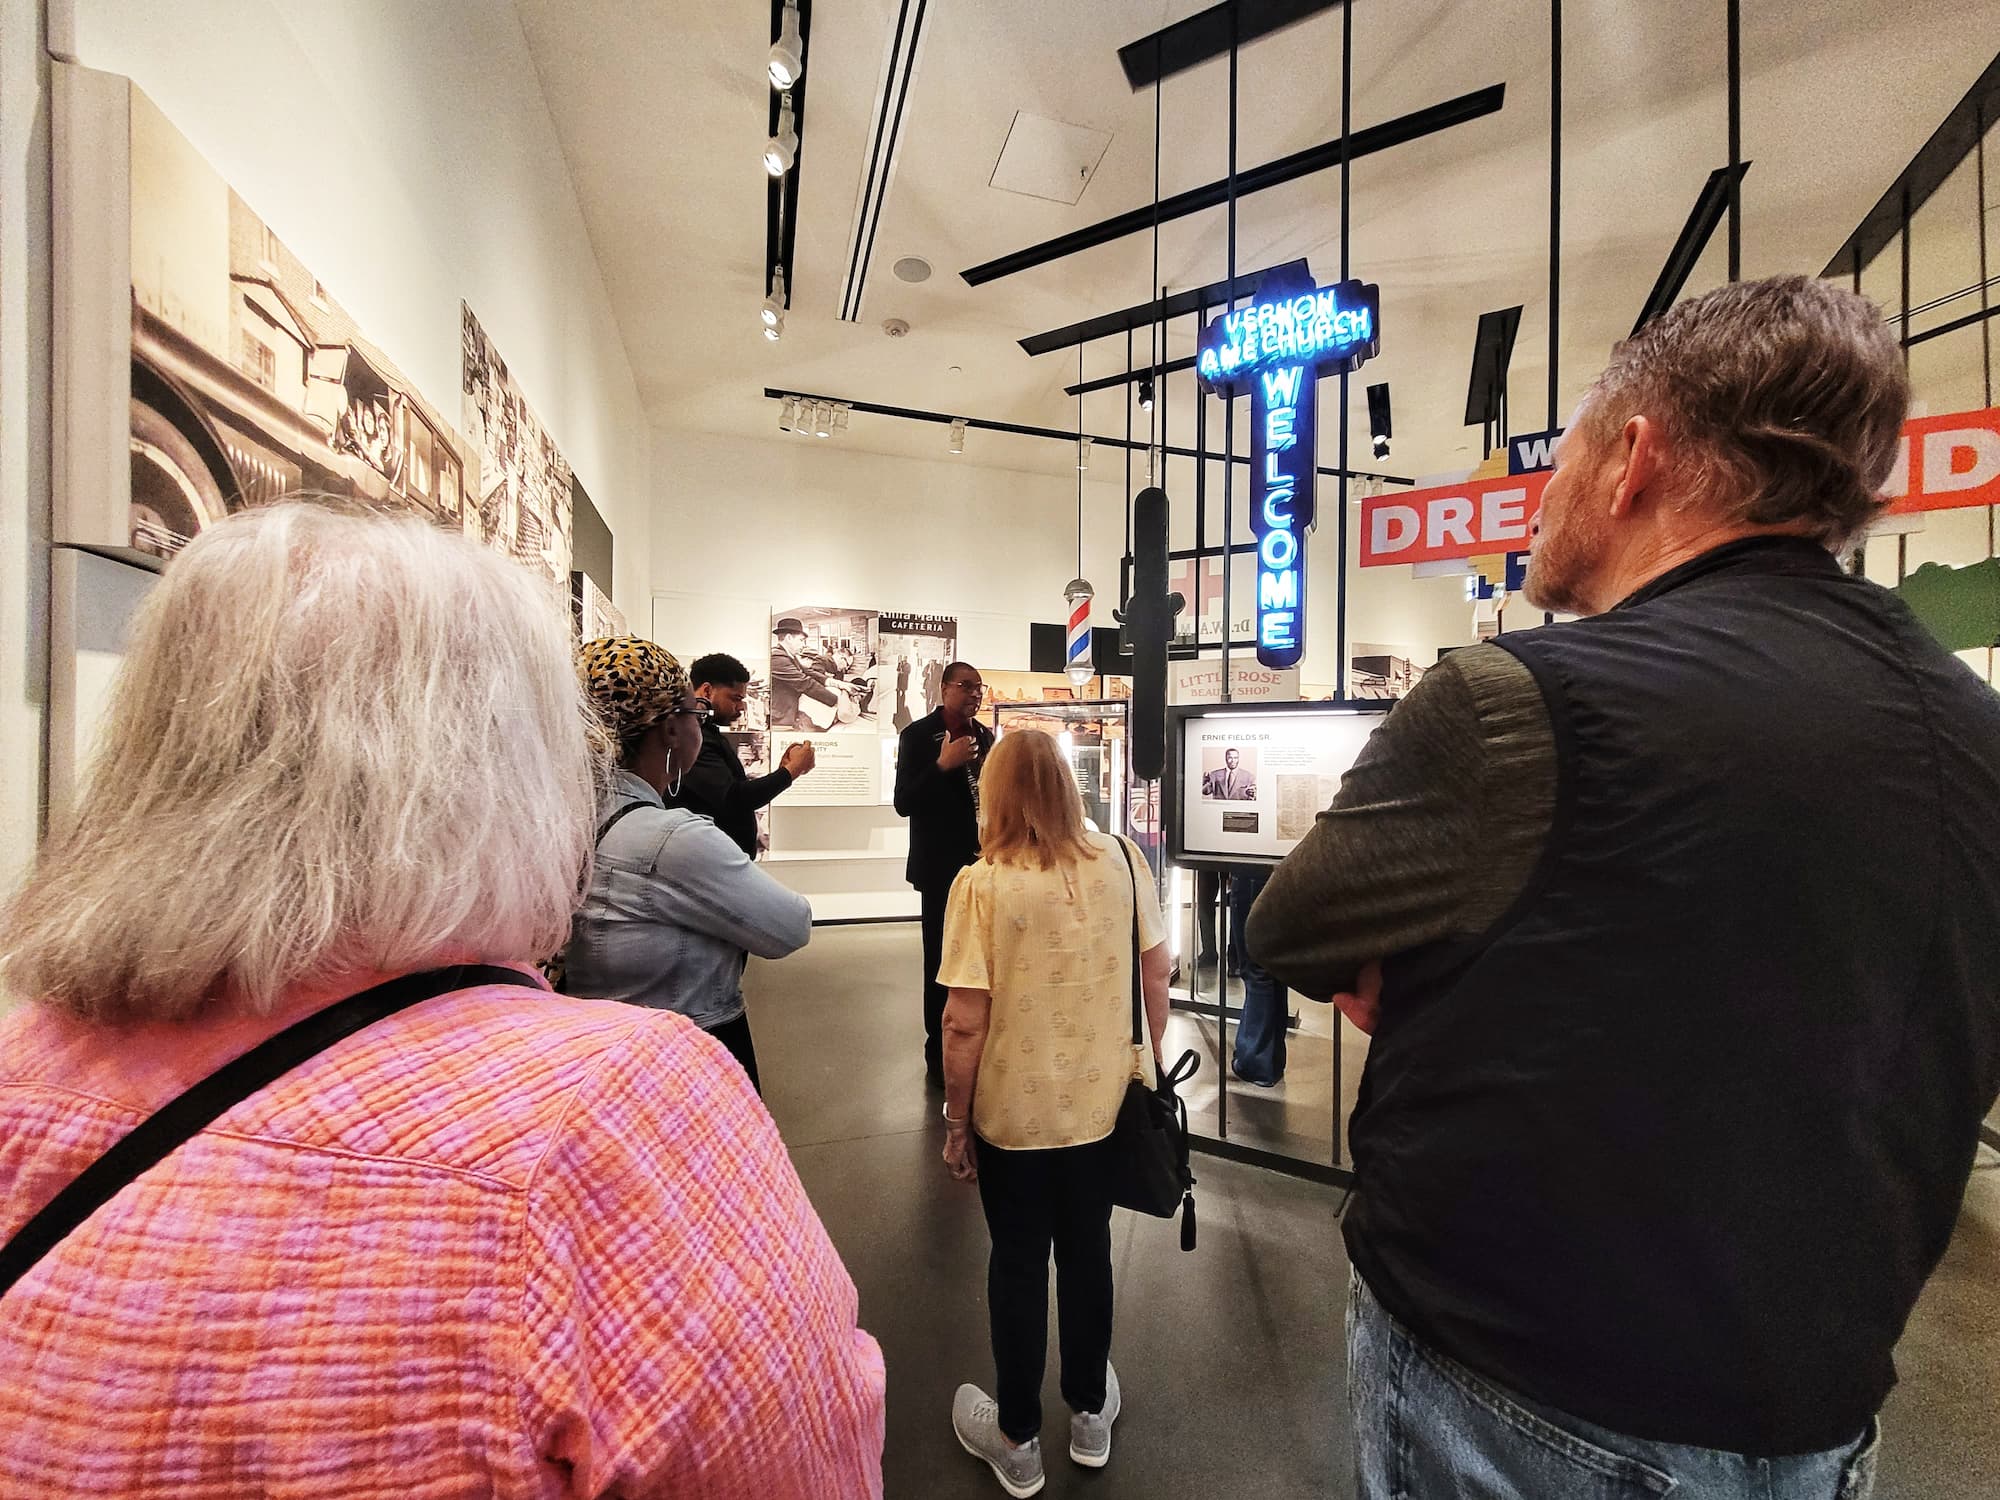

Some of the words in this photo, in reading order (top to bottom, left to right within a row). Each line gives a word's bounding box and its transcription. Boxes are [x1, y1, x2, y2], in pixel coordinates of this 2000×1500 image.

[1225, 290, 1335, 334] VERNON
[1262, 308, 1369, 355] CHURCH
[1261, 366, 1299, 649] WELCOME
[1371, 488, 1527, 554] DRE
[891, 621, 943, 632] CAFETERIA
[1191, 687, 1235, 697] BEAUY
[1238, 686, 1270, 696] SHOP
[1239, 671, 1282, 684] ROSE
